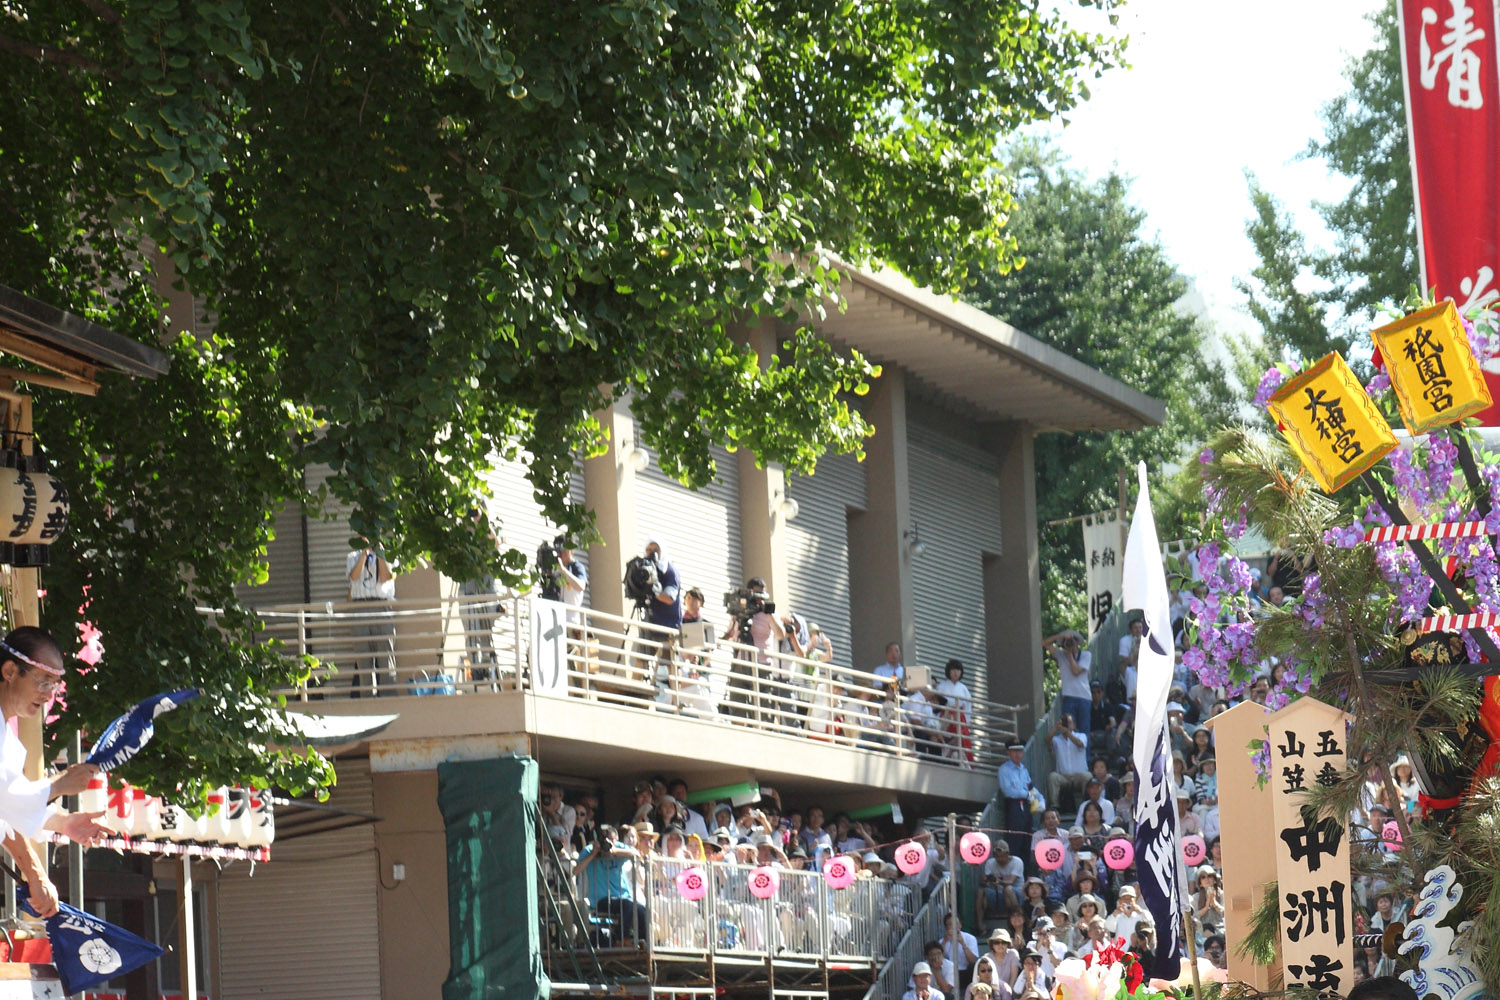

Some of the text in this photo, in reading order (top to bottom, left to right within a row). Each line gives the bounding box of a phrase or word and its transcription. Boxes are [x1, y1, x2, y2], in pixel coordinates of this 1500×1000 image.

[1403, 326, 1454, 413] 祇園宮
[1304, 387, 1364, 464] 大神宮
[1278, 730, 1307, 795] 山笠
